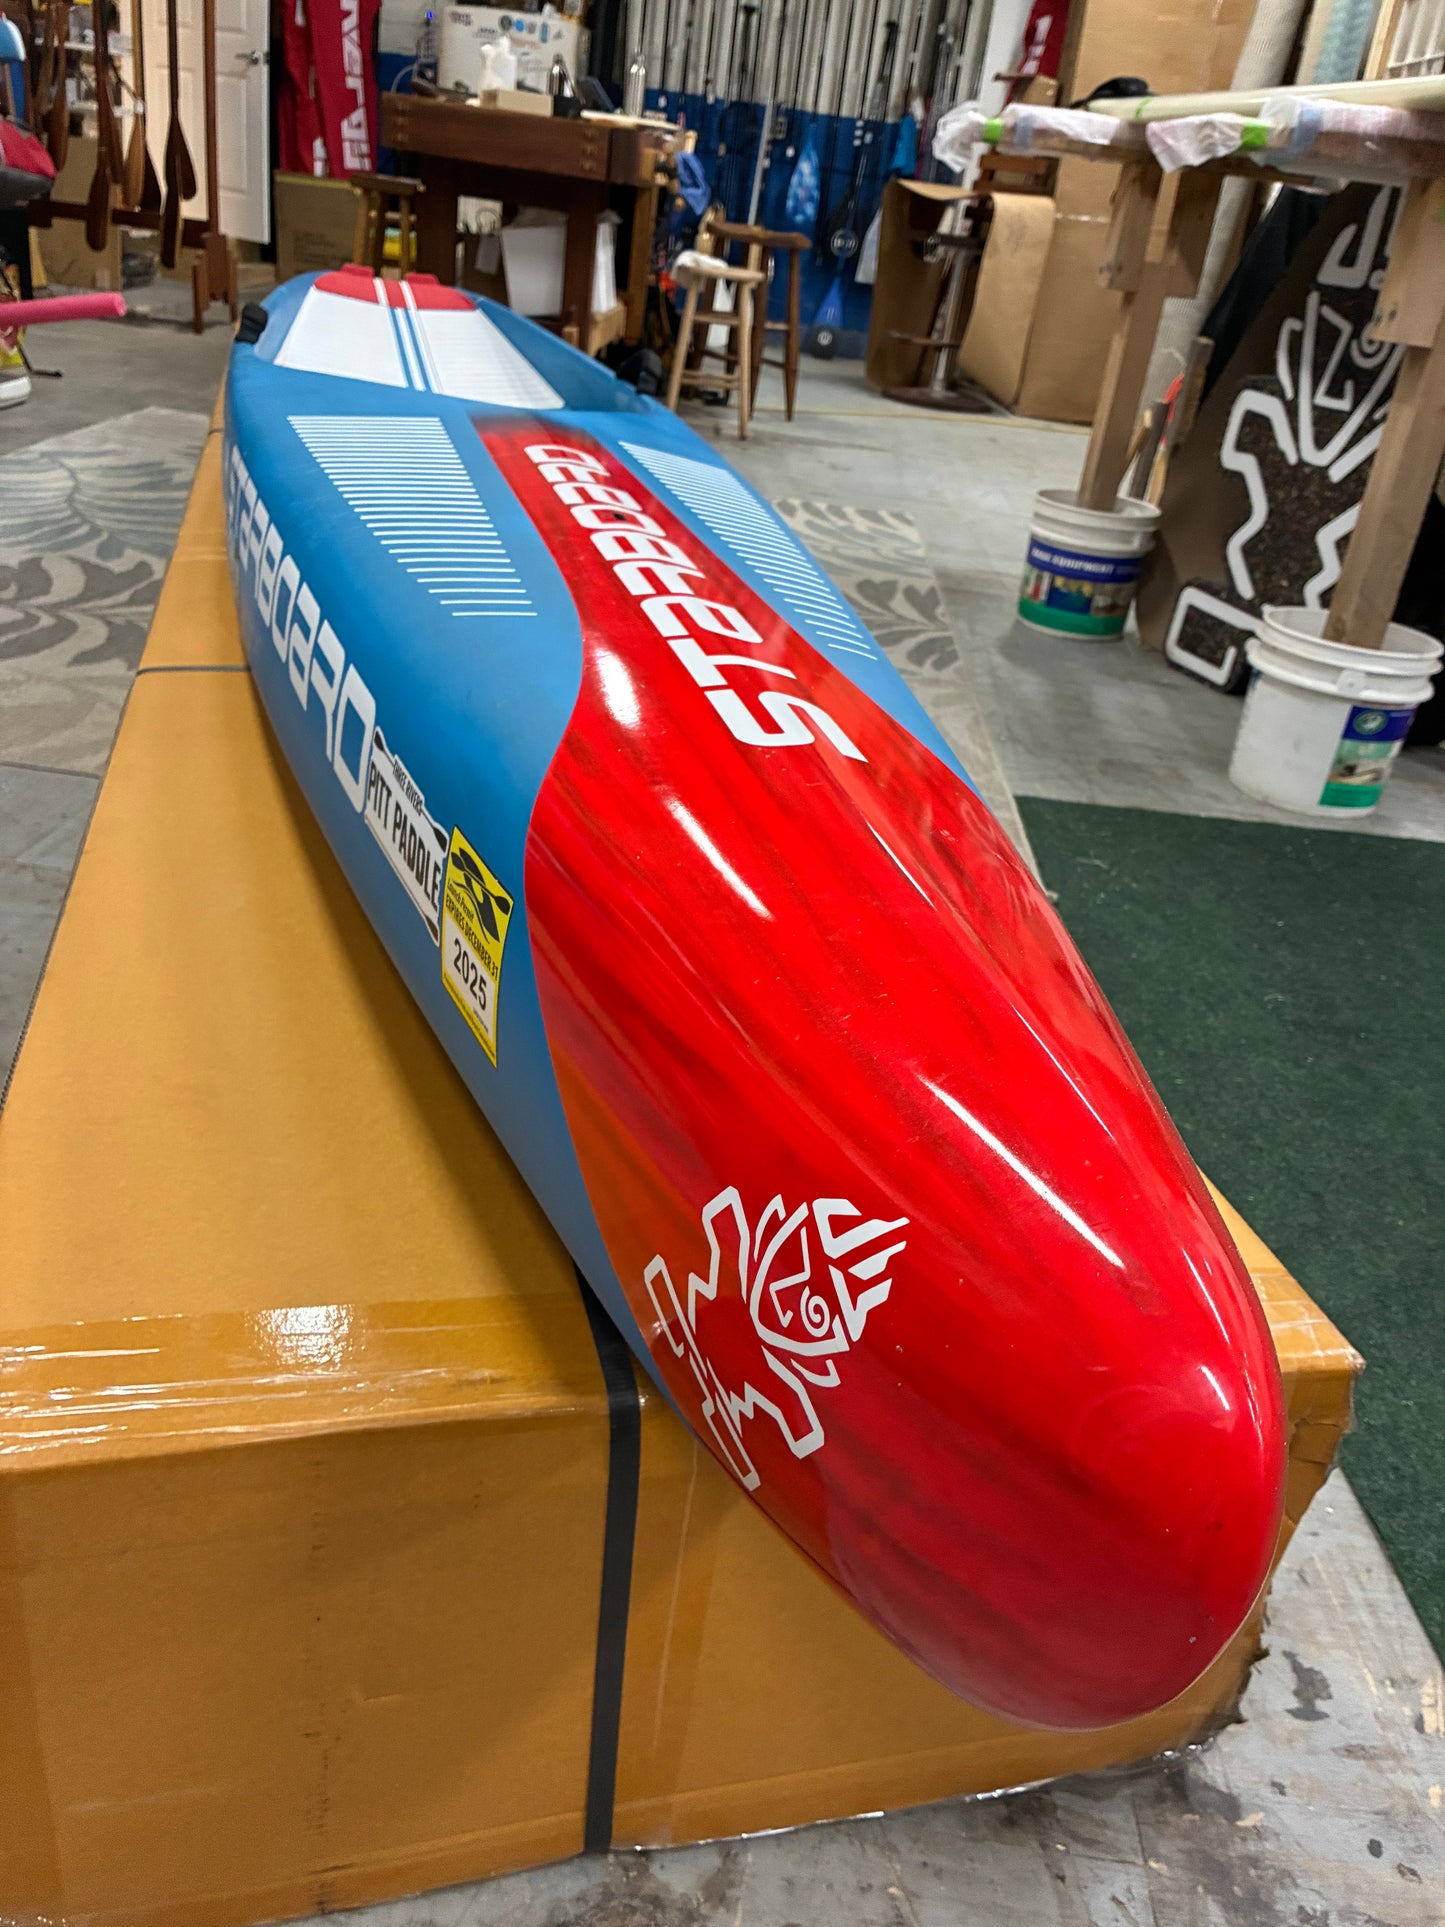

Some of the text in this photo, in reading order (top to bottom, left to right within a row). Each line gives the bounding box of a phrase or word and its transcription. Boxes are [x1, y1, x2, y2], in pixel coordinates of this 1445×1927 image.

[367, 760, 441, 913] PITT PADDLE
[445, 892, 466, 933] EXPIRES
[464, 922, 493, 973] DECEMBER
[453, 937, 488, 1012] 2025
